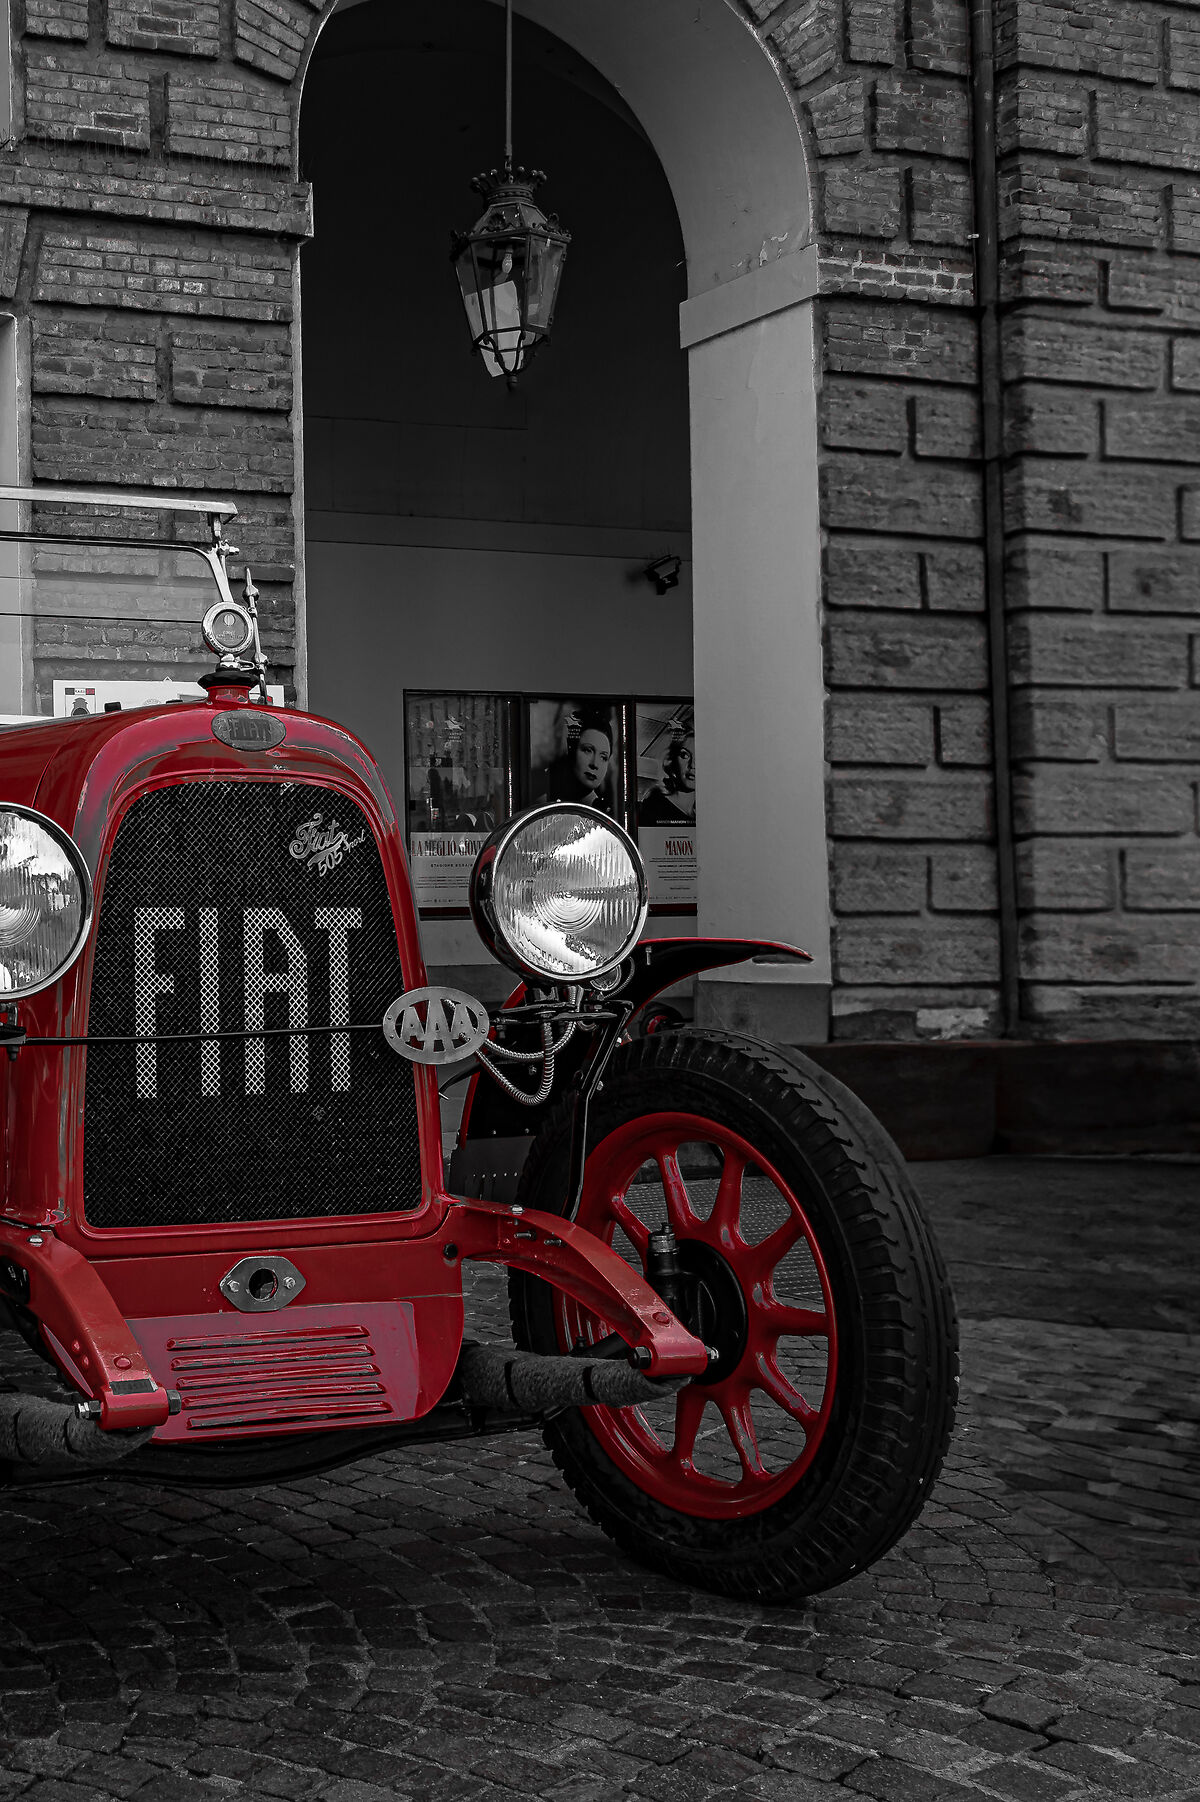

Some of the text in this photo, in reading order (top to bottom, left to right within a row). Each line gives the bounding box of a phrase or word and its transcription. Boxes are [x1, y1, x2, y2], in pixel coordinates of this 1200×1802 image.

[231, 717, 270, 741] FIAT
[288, 812, 343, 859] Fiat
[665, 840, 694, 856] MANON
[317, 850, 343, 877] 505
[134, 907, 362, 1099] FIAT
[400, 998, 472, 1053] AAA
